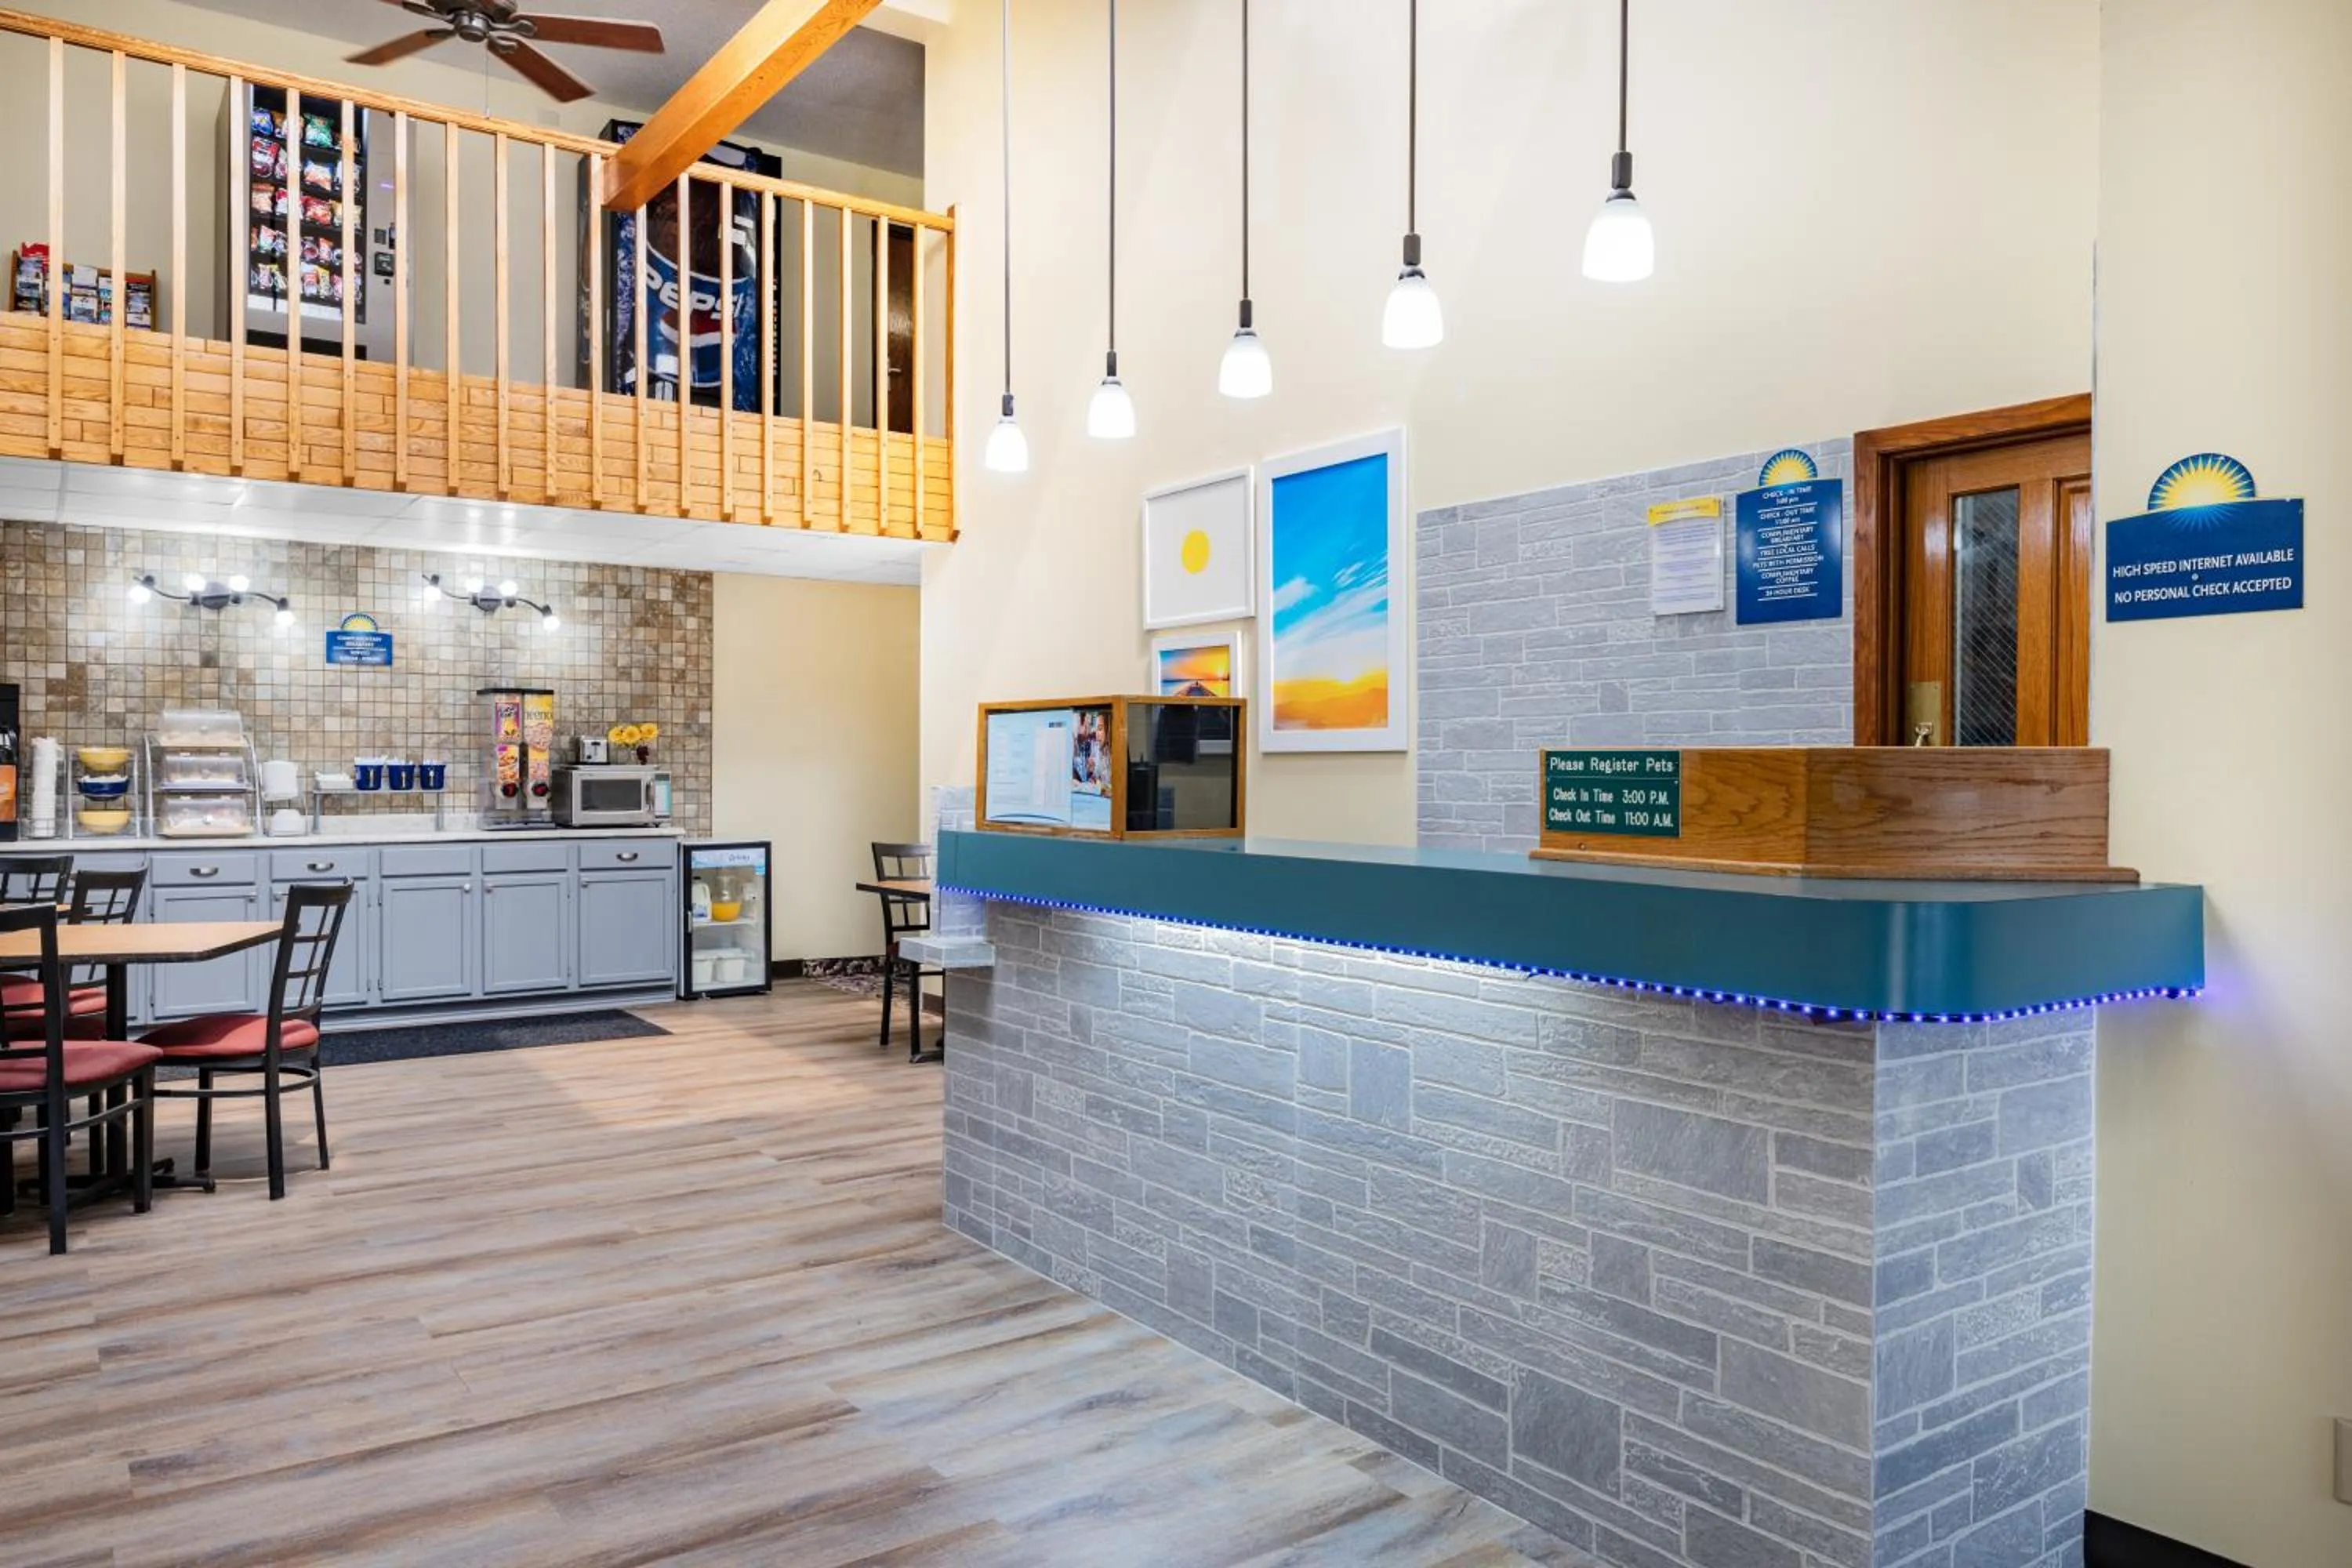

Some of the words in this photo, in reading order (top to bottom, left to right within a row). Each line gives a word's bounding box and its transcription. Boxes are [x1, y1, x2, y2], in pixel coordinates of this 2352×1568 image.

[2113, 565, 2141, 578] HIGH
[2143, 561, 2177, 575] SPEED
[2179, 554, 2234, 572] INTERNET
[2235, 548, 2295, 567] AVAILABLE
[2114, 592, 2132, 604] NO
[2134, 586, 2190, 602] PERSONAL
[2192, 582, 2230, 597] CHECK
[2232, 577, 2292, 594] ACCEPTED
[1550, 757, 1584, 771] Please
[1590, 757, 1639, 774] Register
[1646, 757, 1674, 772] Pets
[1553, 786, 1577, 801] Check
[1580, 788, 1589, 801] In
[1593, 788, 1614, 803] Time
[1622, 789, 1646, 804] 3:00
[1650, 790, 1669, 805] P.M.
[1548, 808, 1572, 822] Check
[1575, 808, 1591, 822] Out
[1595, 810, 1616, 824] Time
[1624, 811, 1649, 826] 11:00
[1653, 812, 1674, 827] A.M.
